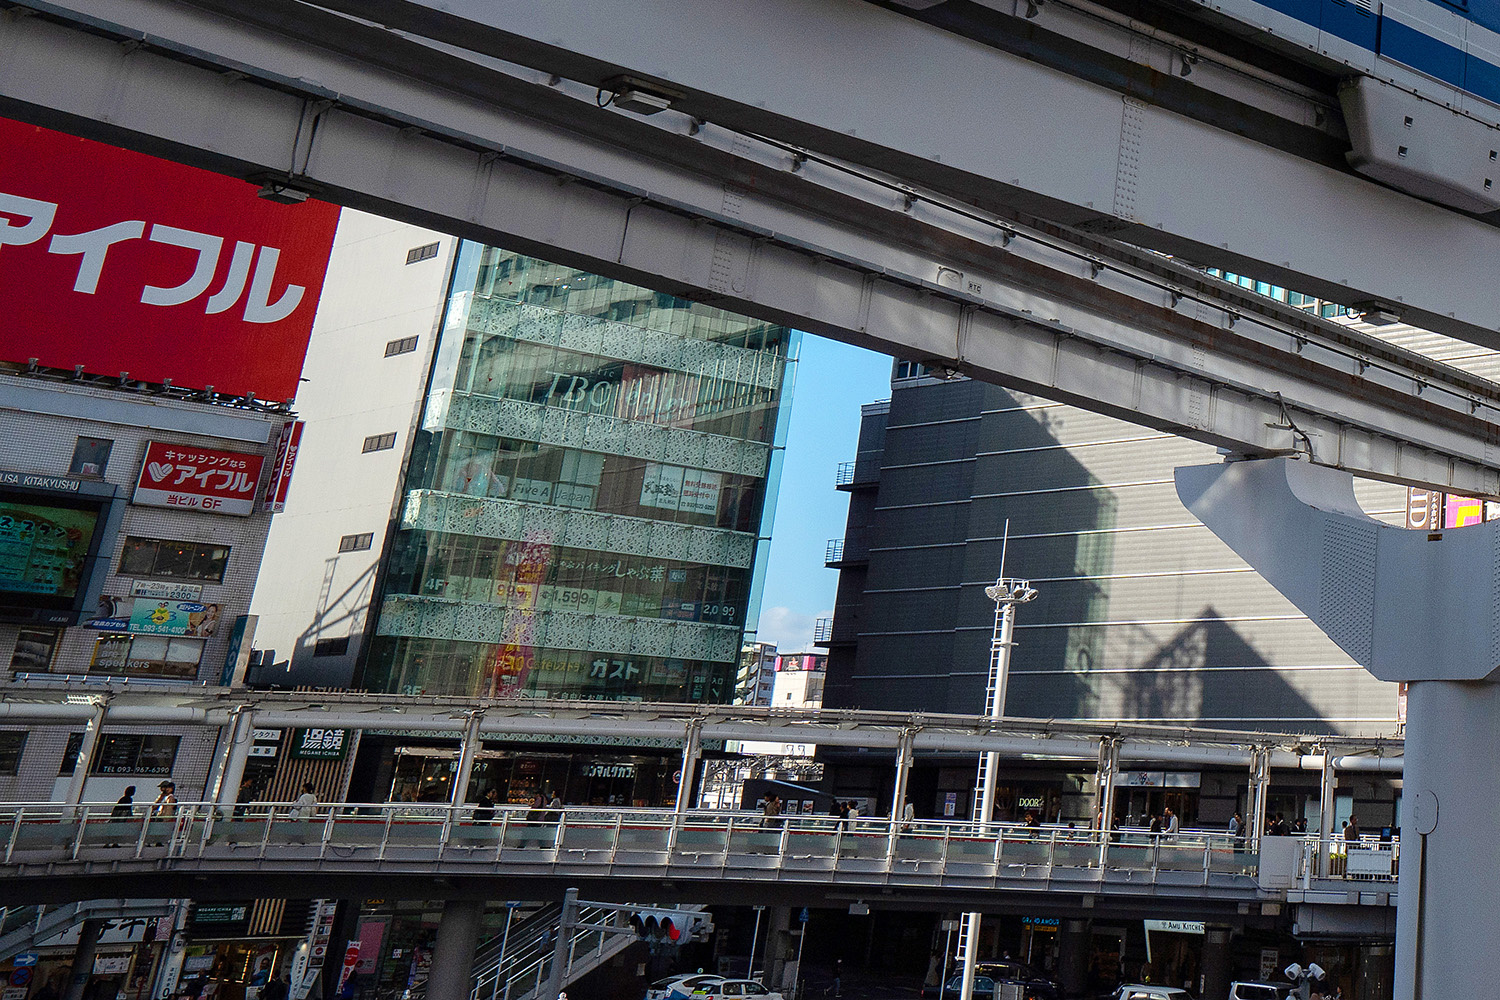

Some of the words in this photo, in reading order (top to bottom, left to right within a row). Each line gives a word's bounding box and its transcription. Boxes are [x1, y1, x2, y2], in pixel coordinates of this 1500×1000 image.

[0, 192, 305, 323] アイフル
[558, 362, 615, 378] esthetic
[165, 450, 247, 469] キャッシングなら
[23, 475, 80, 491] KITAKYUSHU
[173, 465, 254, 493] アイフル
[513, 483, 537, 495] Five
[540, 487, 549, 497] A
[555, 490, 591, 503] Japan
[167, 494, 198, 507] 当ビル
[202, 498, 222, 510] 6F
[615, 560, 665, 583] しゃぶ葉
[425, 578, 444, 591] 4F
[99, 658, 150, 669] speakers
[590, 659, 640, 680] ガスト
[103, 765, 115, 773] TEL
